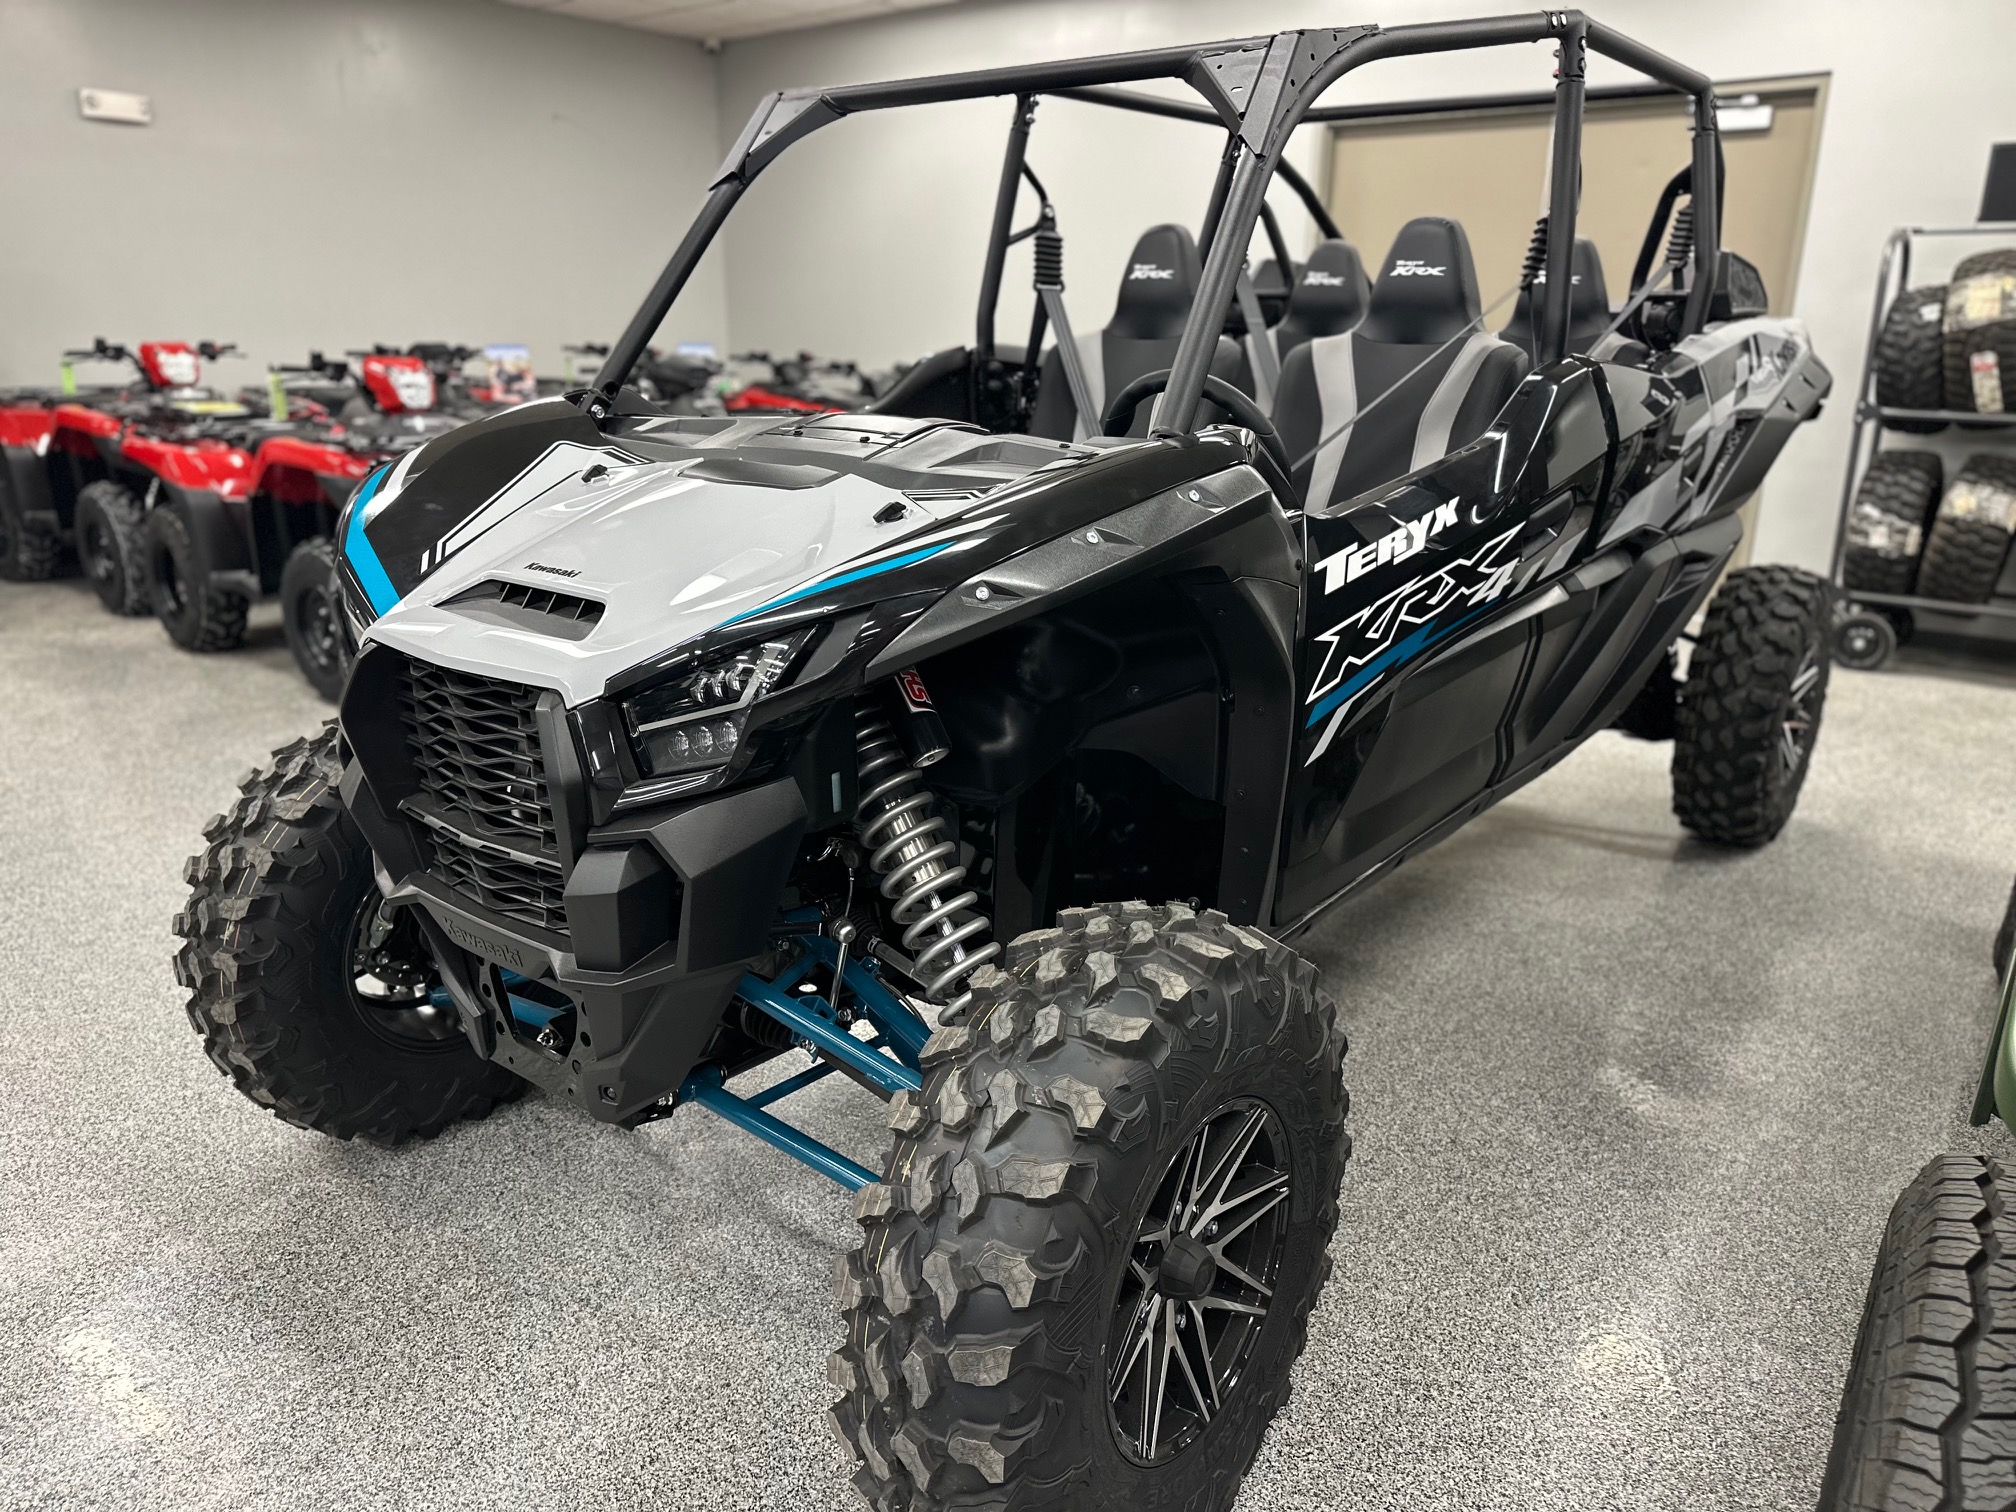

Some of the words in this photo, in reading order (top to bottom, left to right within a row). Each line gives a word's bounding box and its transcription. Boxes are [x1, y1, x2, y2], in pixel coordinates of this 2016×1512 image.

[1389, 266, 1447, 276] KRX
[1314, 496, 1460, 595] TERYX
[523, 562, 582, 578] Kawasaki
[443, 916, 523, 967] Kawasaki
